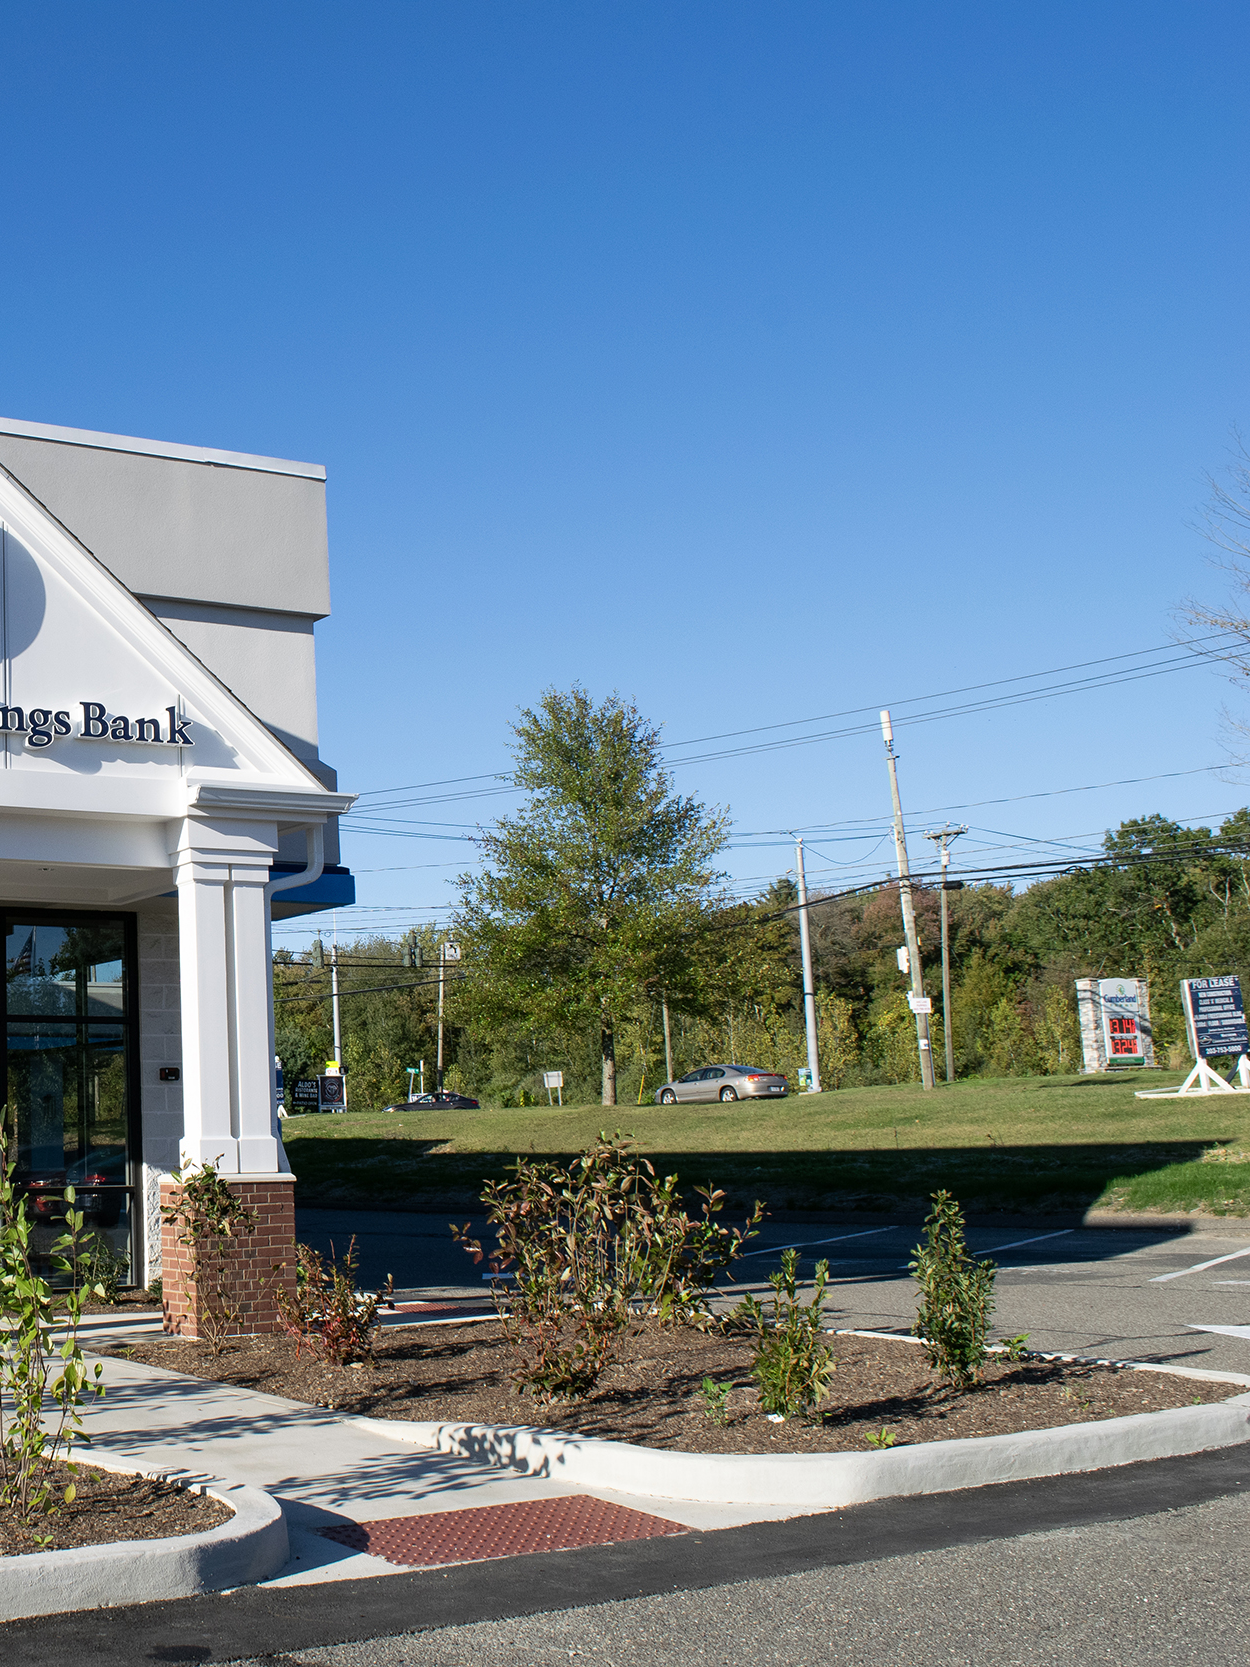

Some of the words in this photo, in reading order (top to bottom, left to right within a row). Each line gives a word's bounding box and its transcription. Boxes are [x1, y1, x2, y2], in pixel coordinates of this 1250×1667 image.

[79, 699, 195, 747] Bank
[1192, 979, 1208, 989] FOR
[1209, 977, 1235, 987] LEASE
[1104, 994, 1136, 1002] Cumberland
